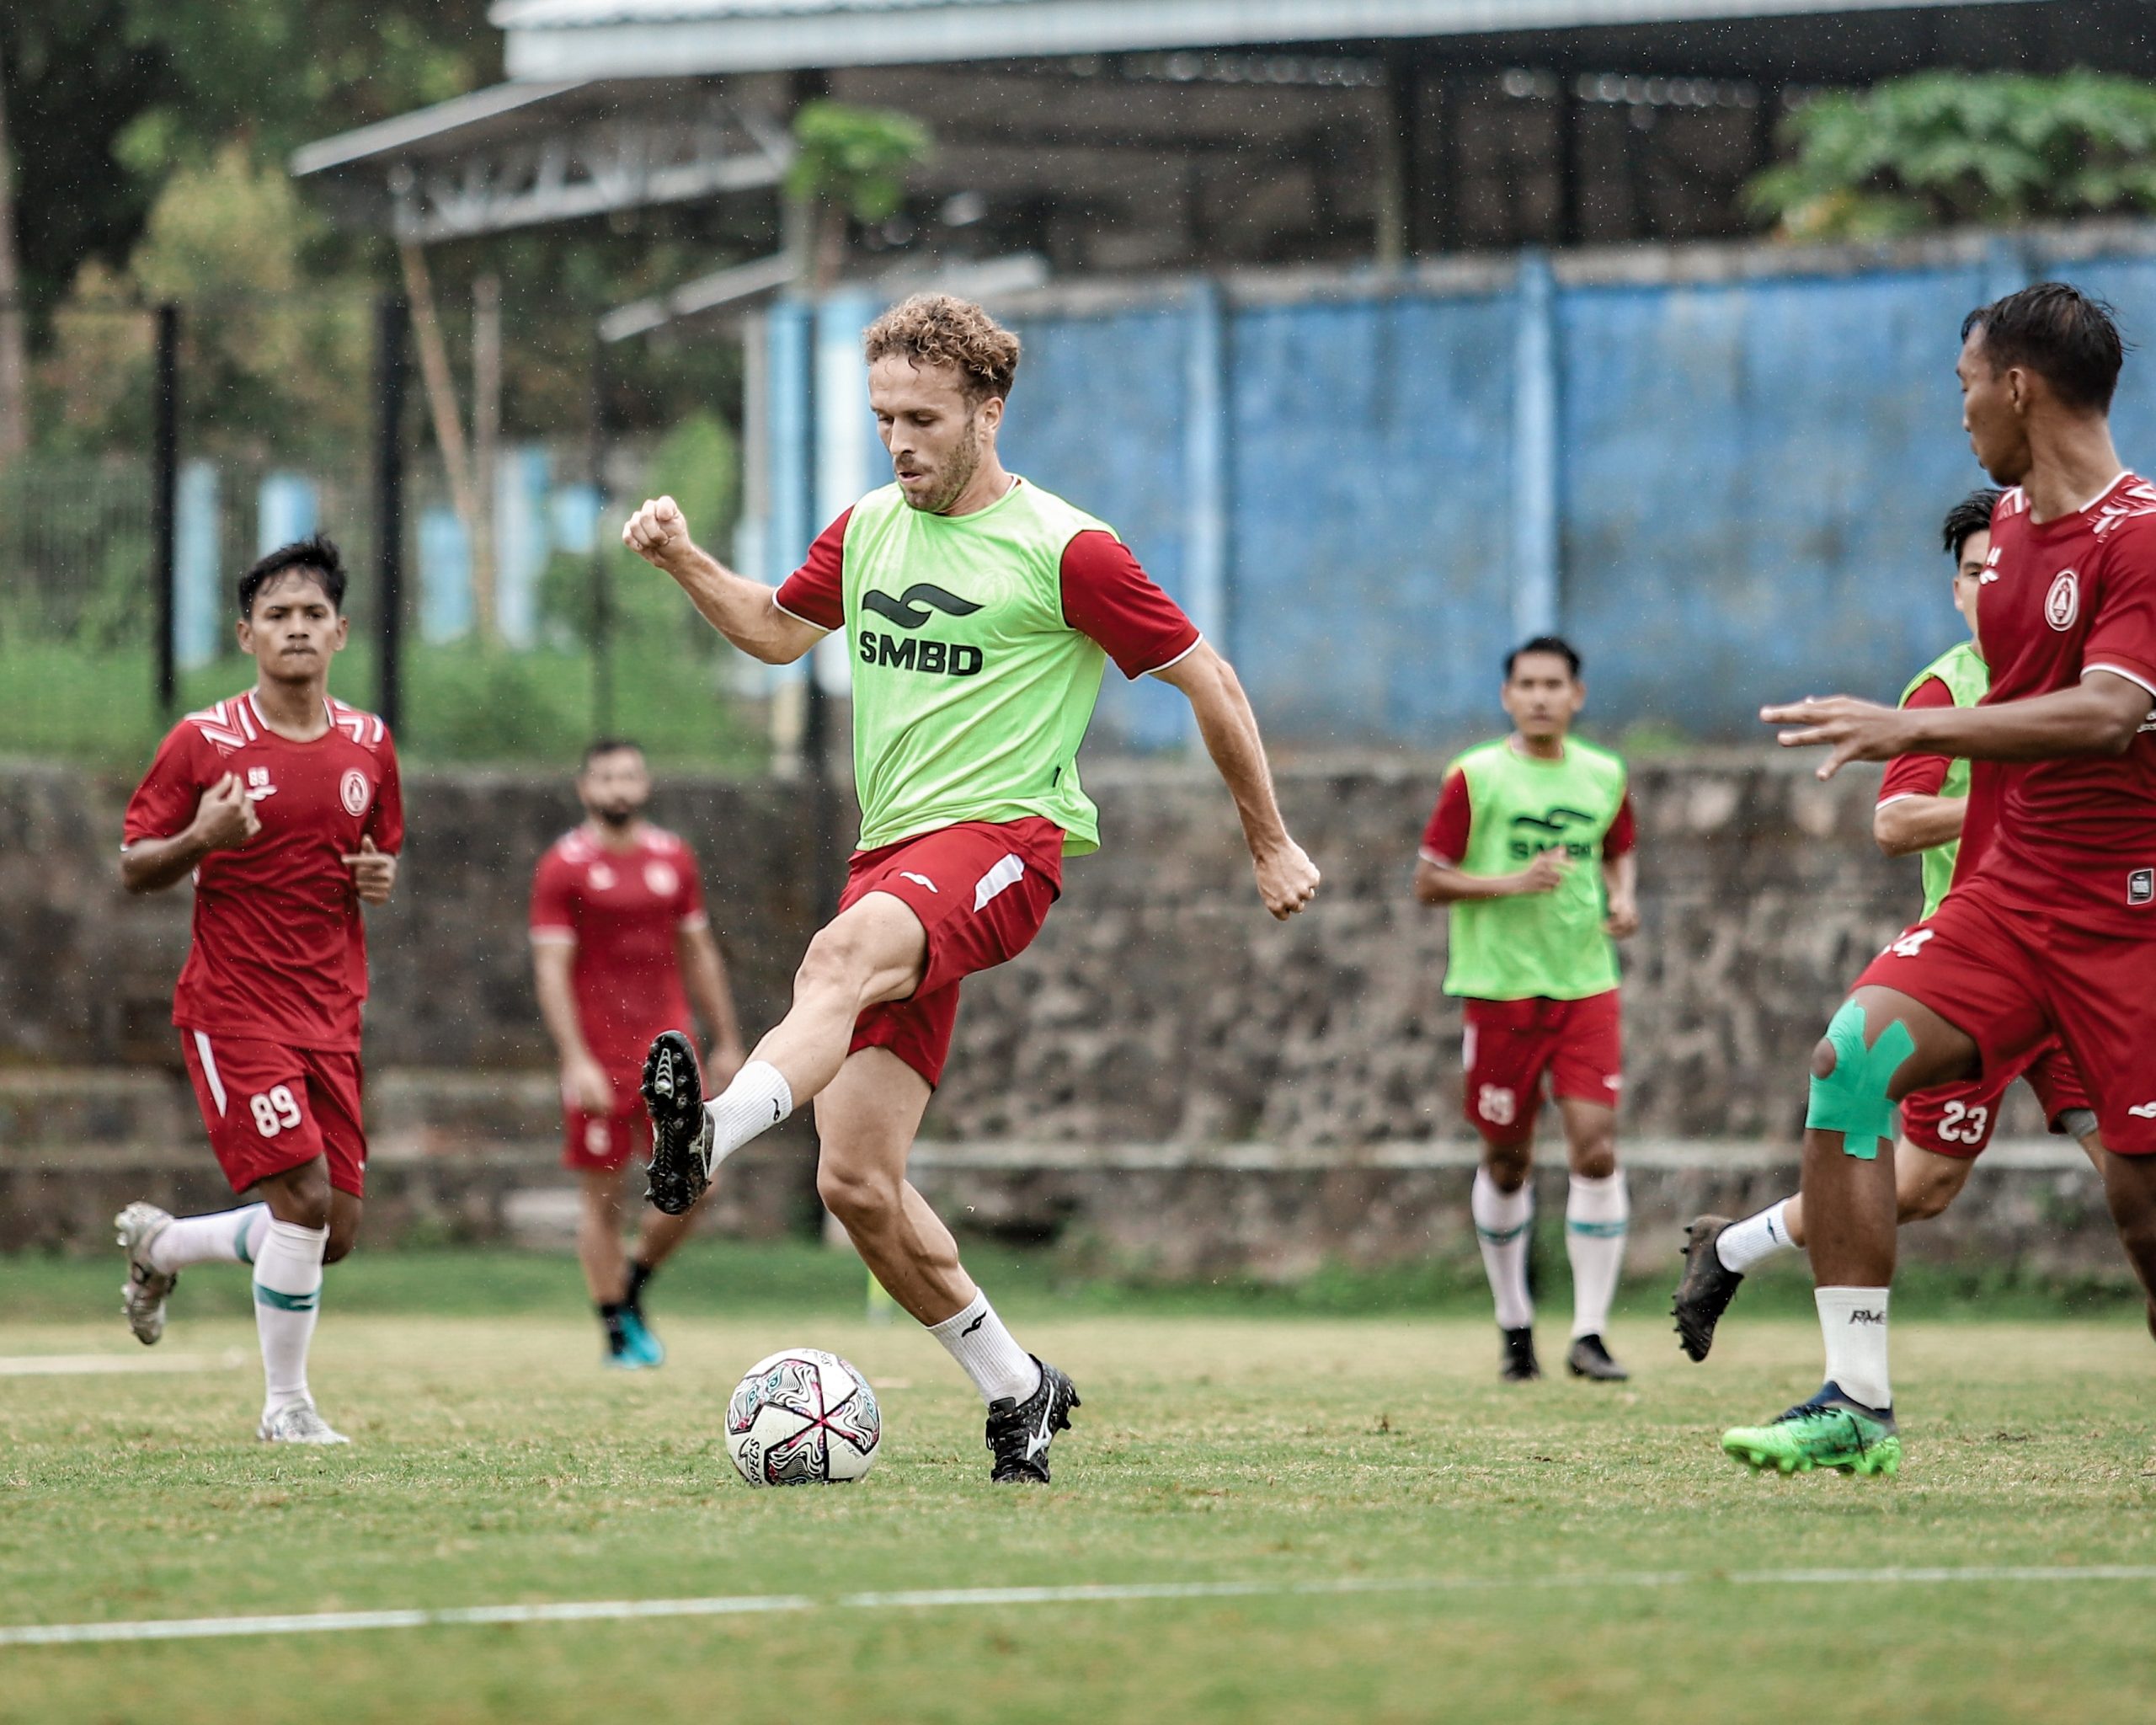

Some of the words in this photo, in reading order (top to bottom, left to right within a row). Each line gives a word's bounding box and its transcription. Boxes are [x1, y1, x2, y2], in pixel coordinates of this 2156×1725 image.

[860, 631, 983, 676] SMBD
[249, 1084, 302, 1139] 89
[1937, 1100, 1988, 1145] 23
[746, 1439, 761, 1484] SPECS
